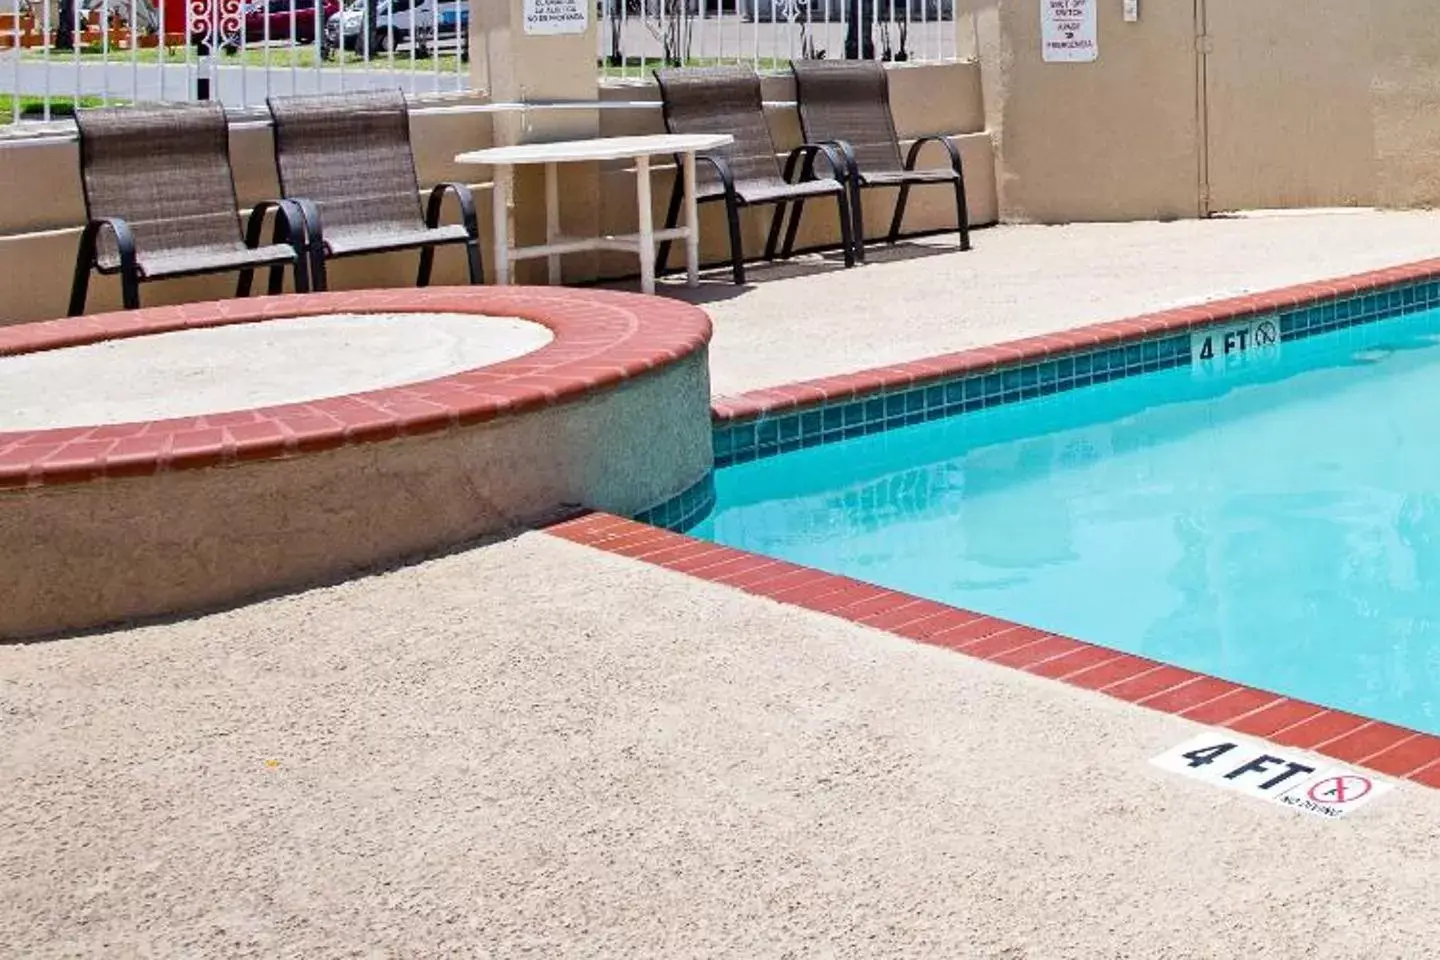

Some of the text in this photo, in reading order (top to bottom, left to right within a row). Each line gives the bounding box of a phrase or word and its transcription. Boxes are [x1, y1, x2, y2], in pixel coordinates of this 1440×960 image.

[1199, 328, 1249, 360] 4 FT
[1181, 742, 1316, 790] 4 FT
